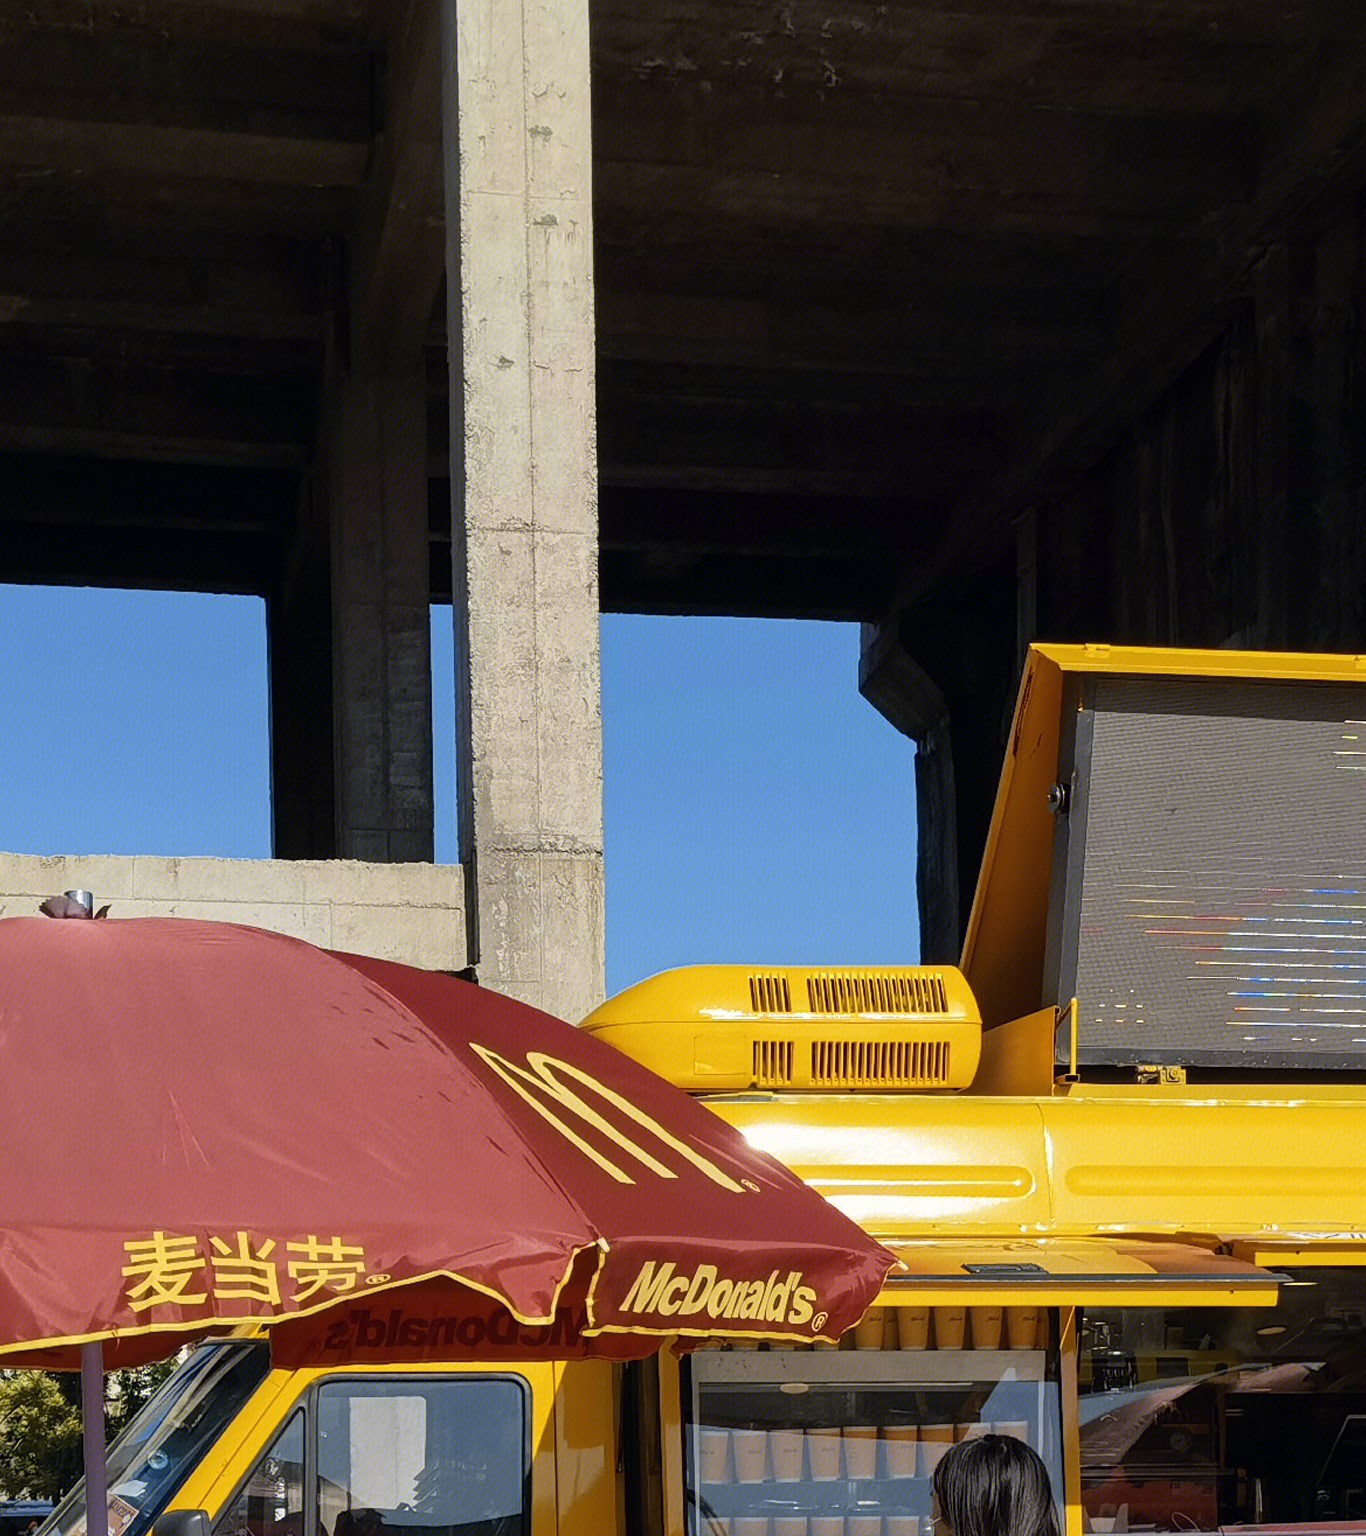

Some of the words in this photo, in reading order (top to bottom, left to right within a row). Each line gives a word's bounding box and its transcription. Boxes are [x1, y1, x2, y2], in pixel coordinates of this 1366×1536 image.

[121, 1231, 366, 1312] 麦当劳
[619, 1260, 818, 1325] McDonald's
